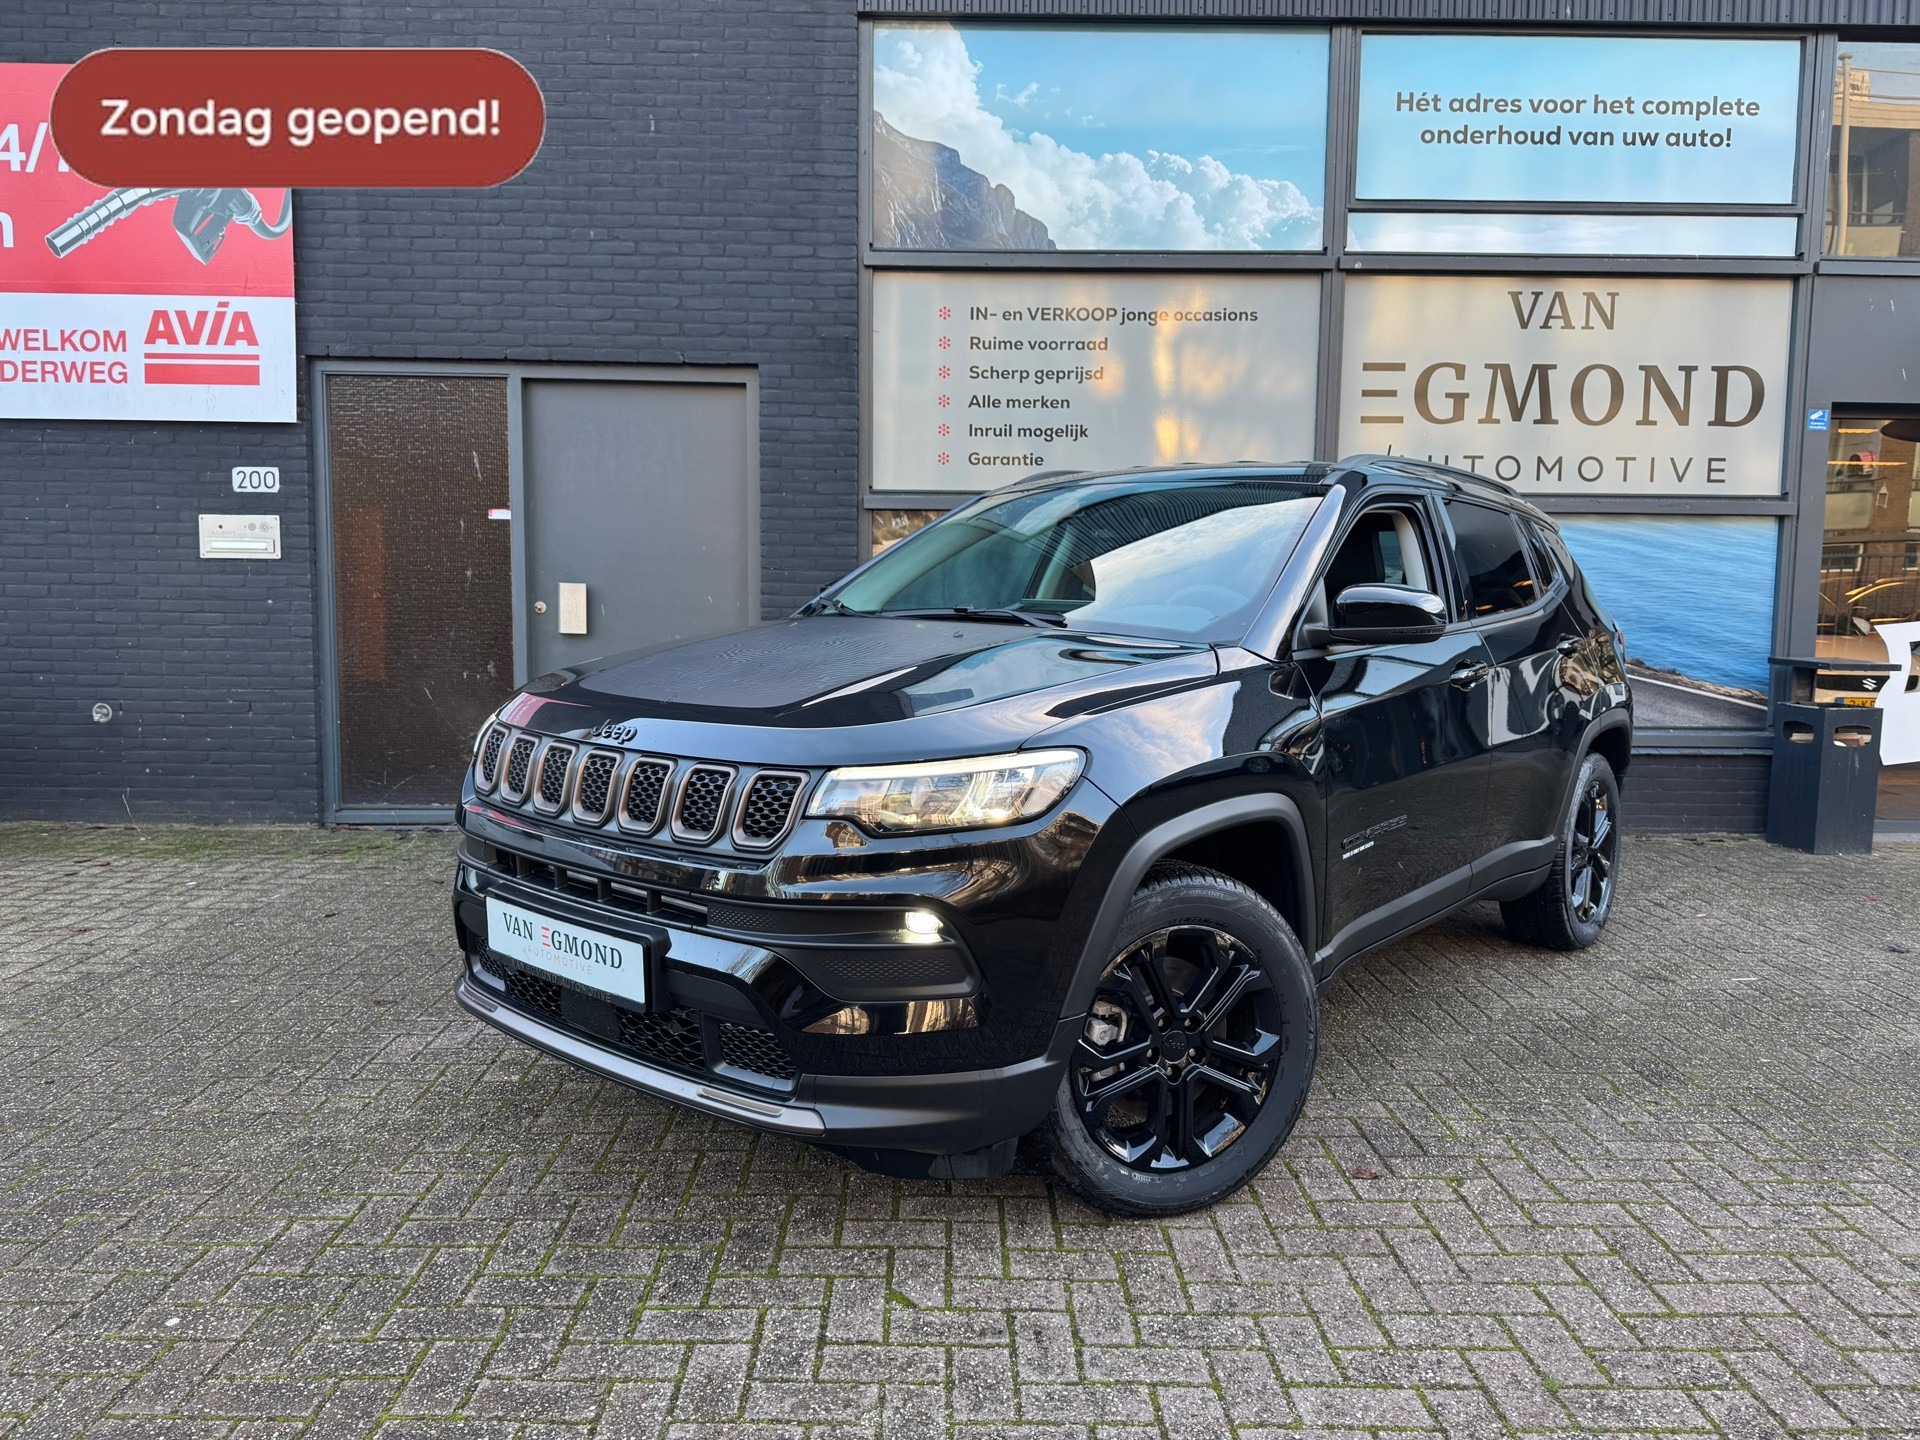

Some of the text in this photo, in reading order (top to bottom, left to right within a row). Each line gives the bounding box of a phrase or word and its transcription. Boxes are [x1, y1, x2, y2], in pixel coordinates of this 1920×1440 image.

[1396, 91, 1760, 121] Hét adres voor het complete
[1420, 124, 1732, 148] onderhoud van uw auto!
[970, 307, 1258, 326] IN- en VERKOOP jonge occasions
[1507, 290, 1619, 331] VAN
[969, 337, 1108, 351] Ruime voorraad
[969, 366, 1104, 385] Scherp geprijsd
[968, 395, 1070, 409] Alle merken
[1360, 361, 1766, 428] EGMOND
[969, 424, 1089, 442] Inruil mogelijk
[968, 453, 1044, 467] Garantie
[236, 470, 276, 489] 200
[591, 719, 638, 745] Jeep
[502, 912, 623, 969] VAN EGMOND
[527, 945, 593, 975] AUTOMOTIVE
[560, 977, 611, 1001] AUTOMOTIVE
